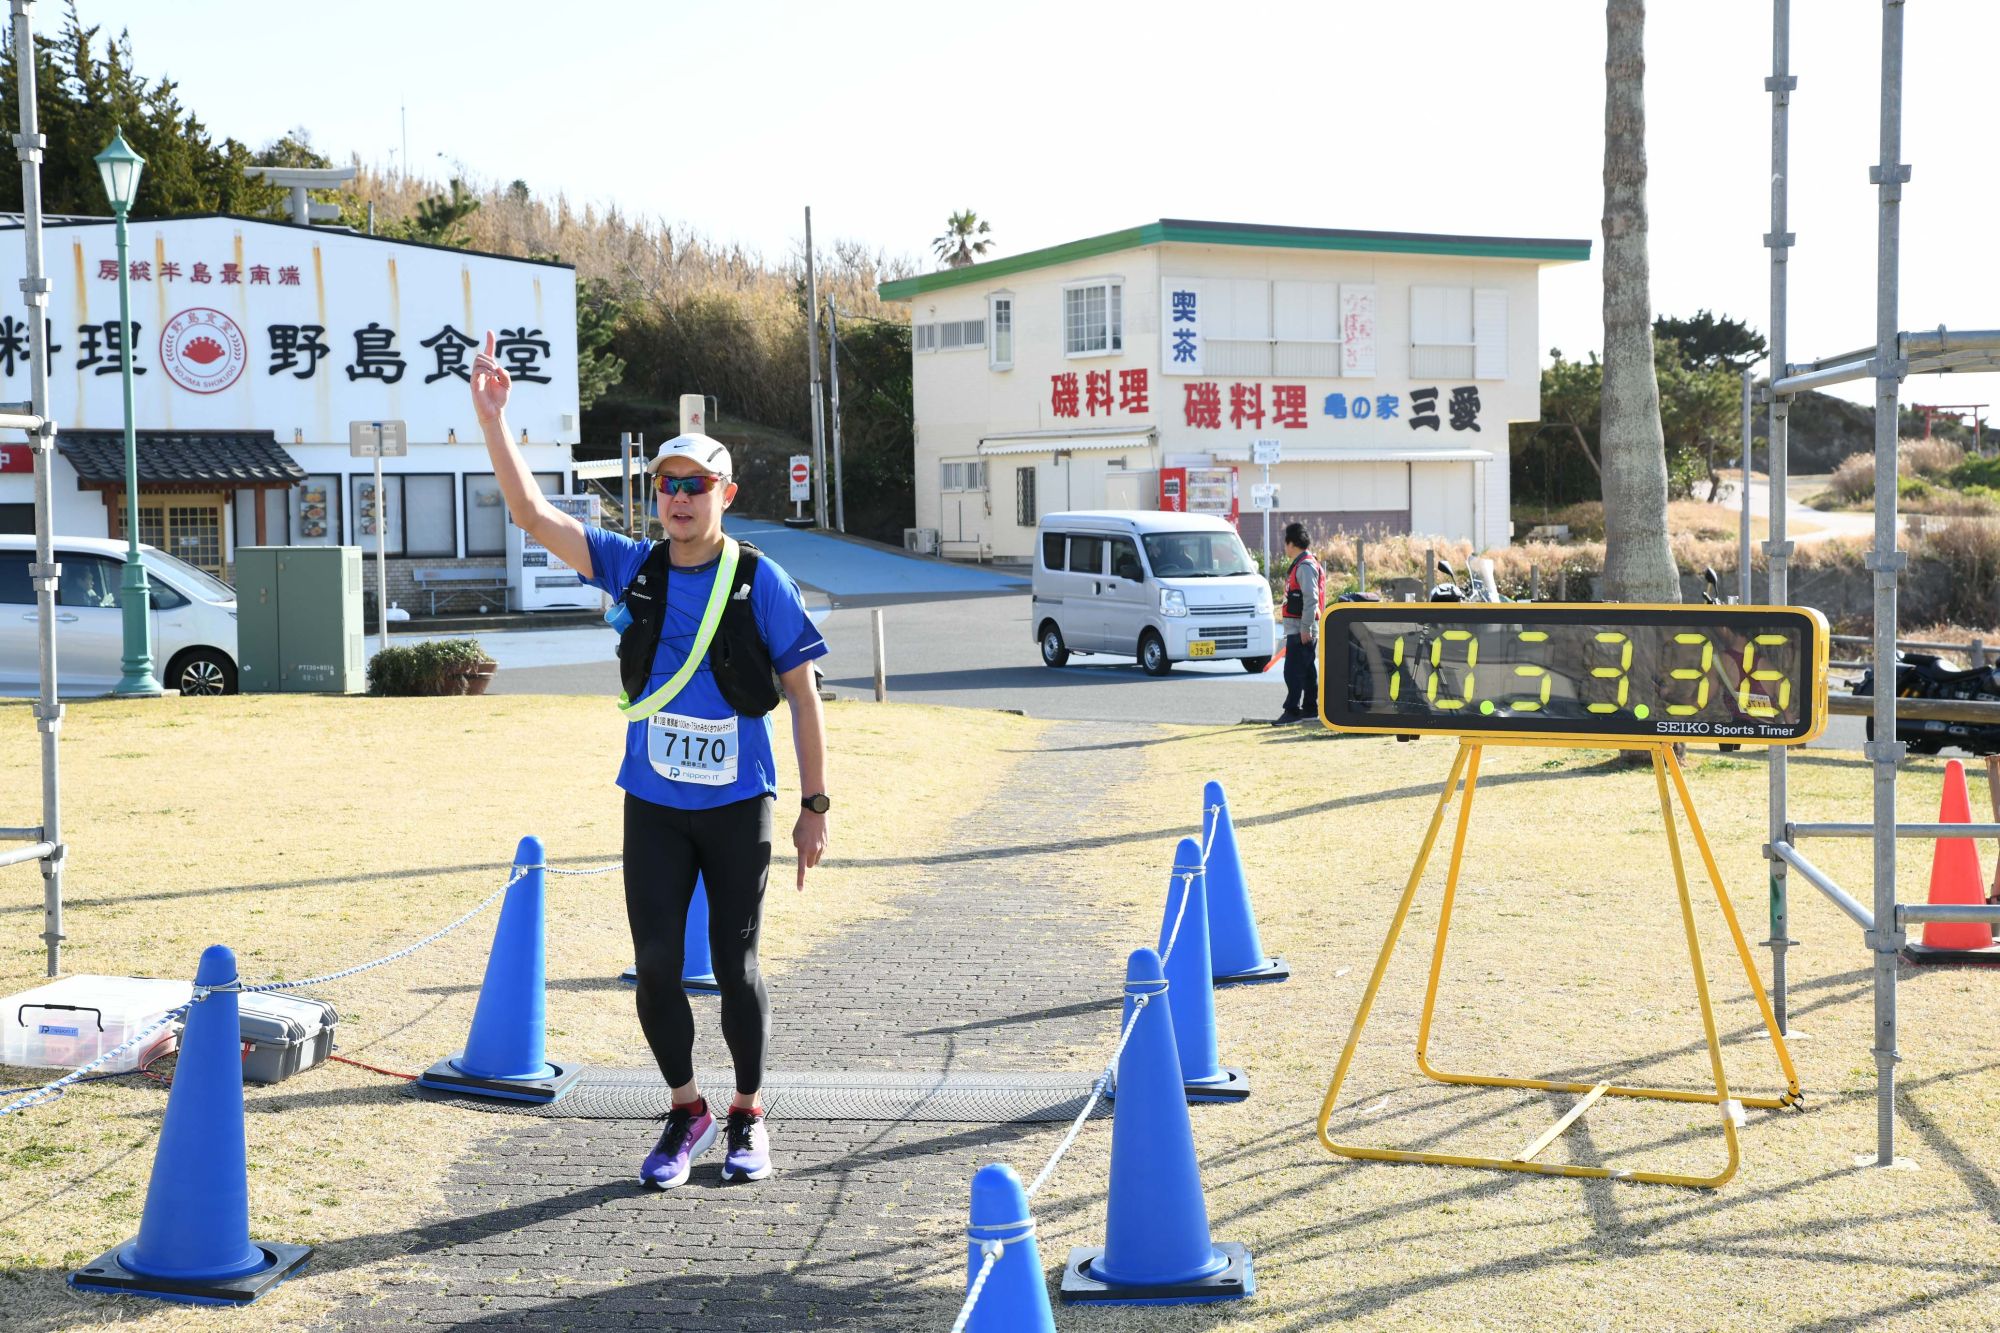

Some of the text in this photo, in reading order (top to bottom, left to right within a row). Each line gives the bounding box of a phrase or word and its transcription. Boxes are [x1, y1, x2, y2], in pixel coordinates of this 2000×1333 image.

[97, 259, 301, 287] 房総半島最南端
[1172, 290, 1197, 363] 喫茶
[267, 322, 553, 385] 野島食堂
[173, 364, 237, 388] NOJIMA SHOKUDO
[1051, 368, 1149, 418] 磯料理
[1184, 382, 1482, 433] 磯料理 亀の家 三愛
[664, 732, 726, 764] 7170
[1656, 721, 1795, 736] SEIKO Sports Timer
